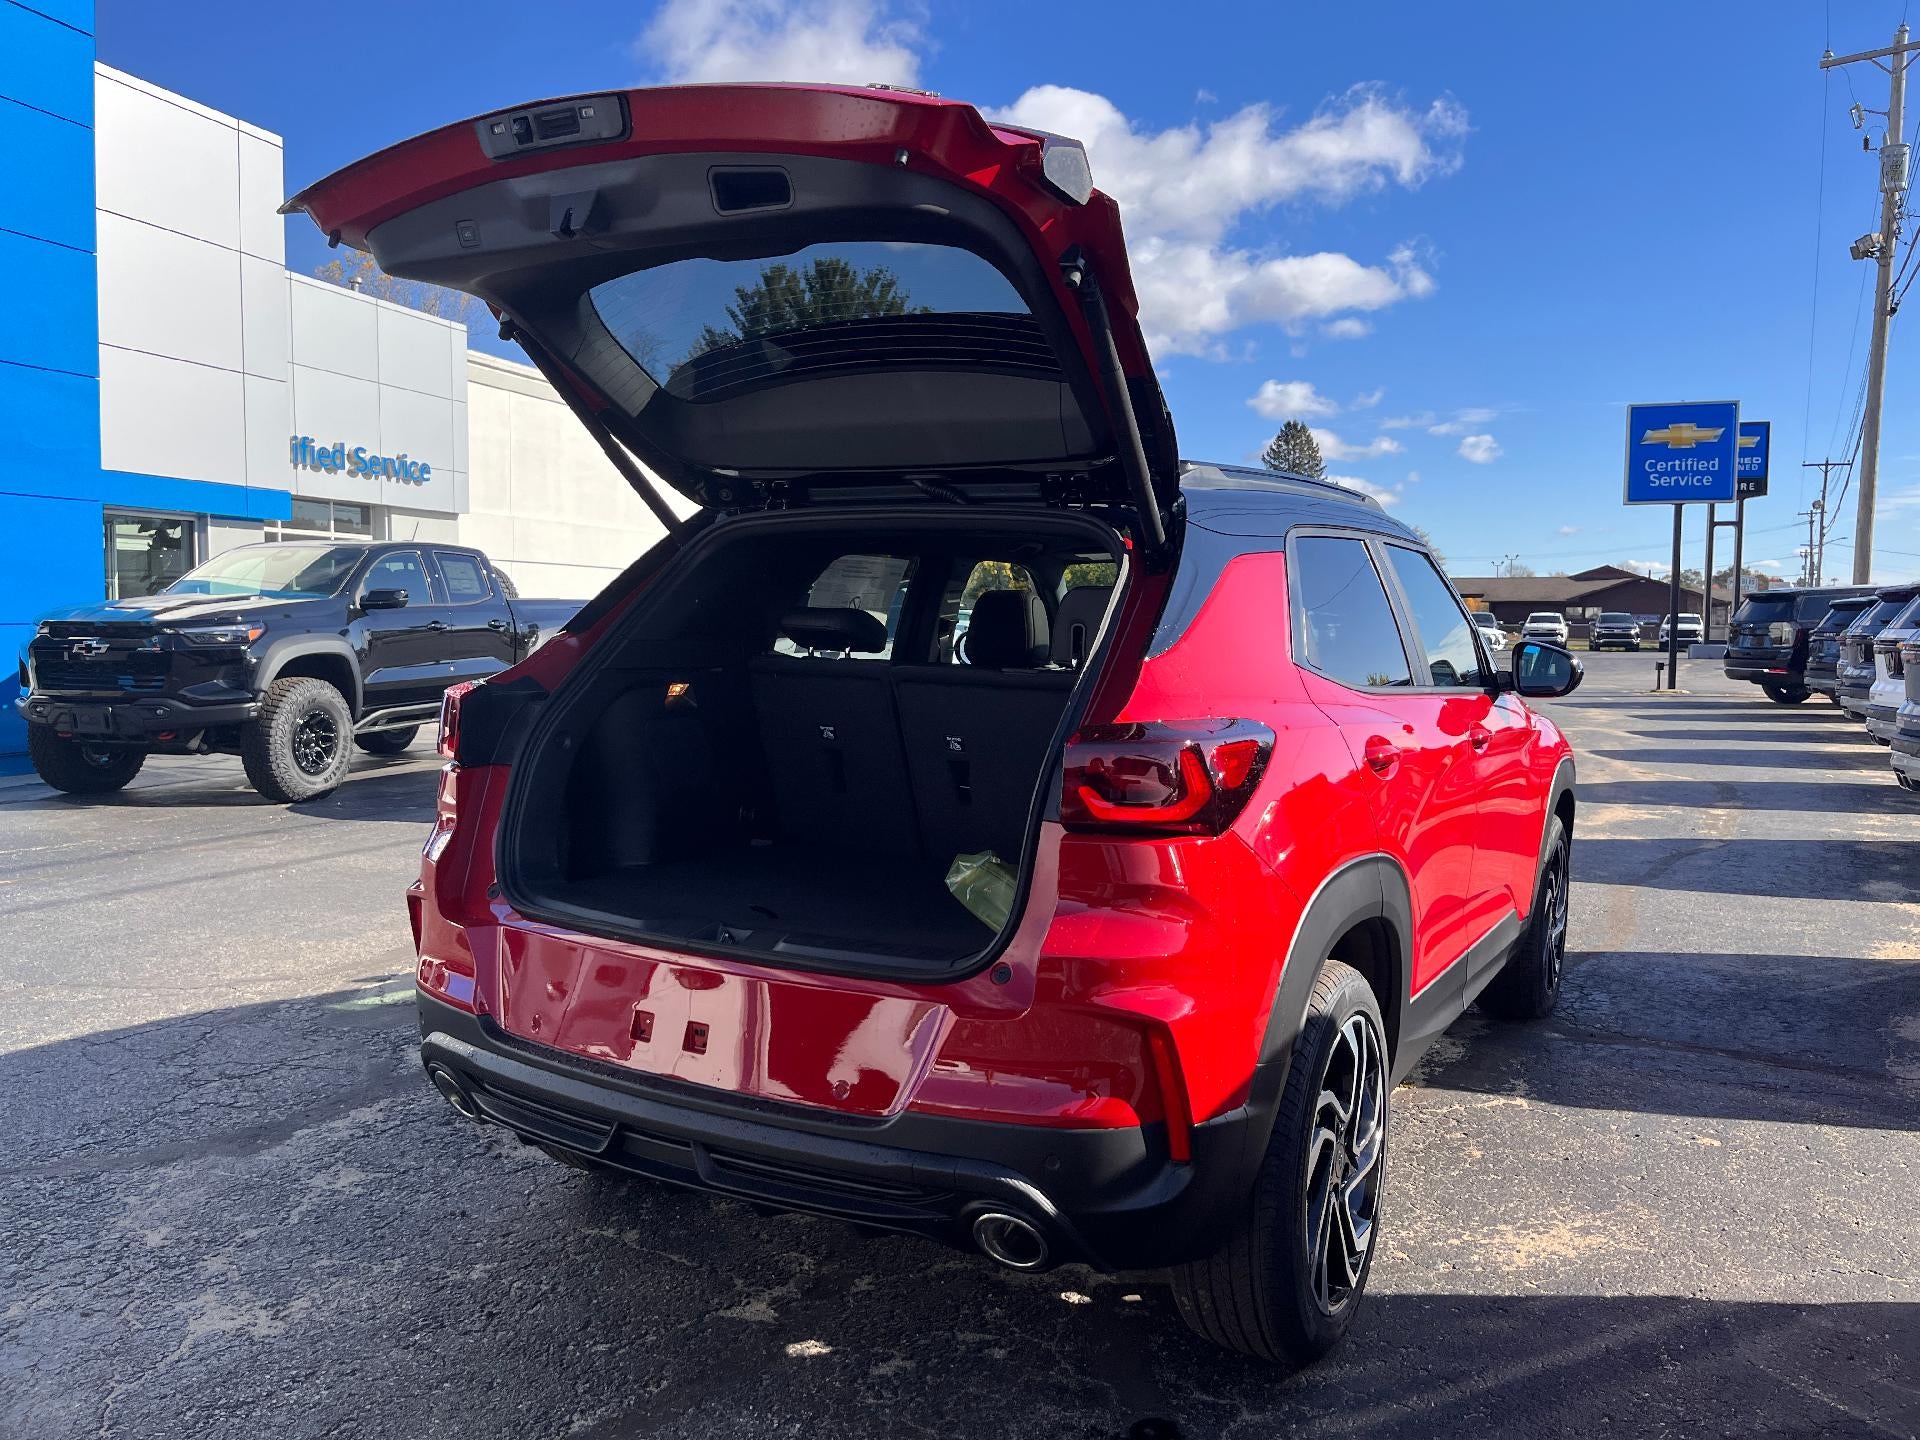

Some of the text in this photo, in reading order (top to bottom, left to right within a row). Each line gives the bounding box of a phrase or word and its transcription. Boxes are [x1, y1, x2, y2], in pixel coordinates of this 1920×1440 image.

[350, 447, 431, 484] Service
[1644, 457, 1719, 472] Certified
[1737, 456, 1762, 464] IED
[1649, 472, 1713, 487] Service
[1737, 482, 1755, 491] RE
